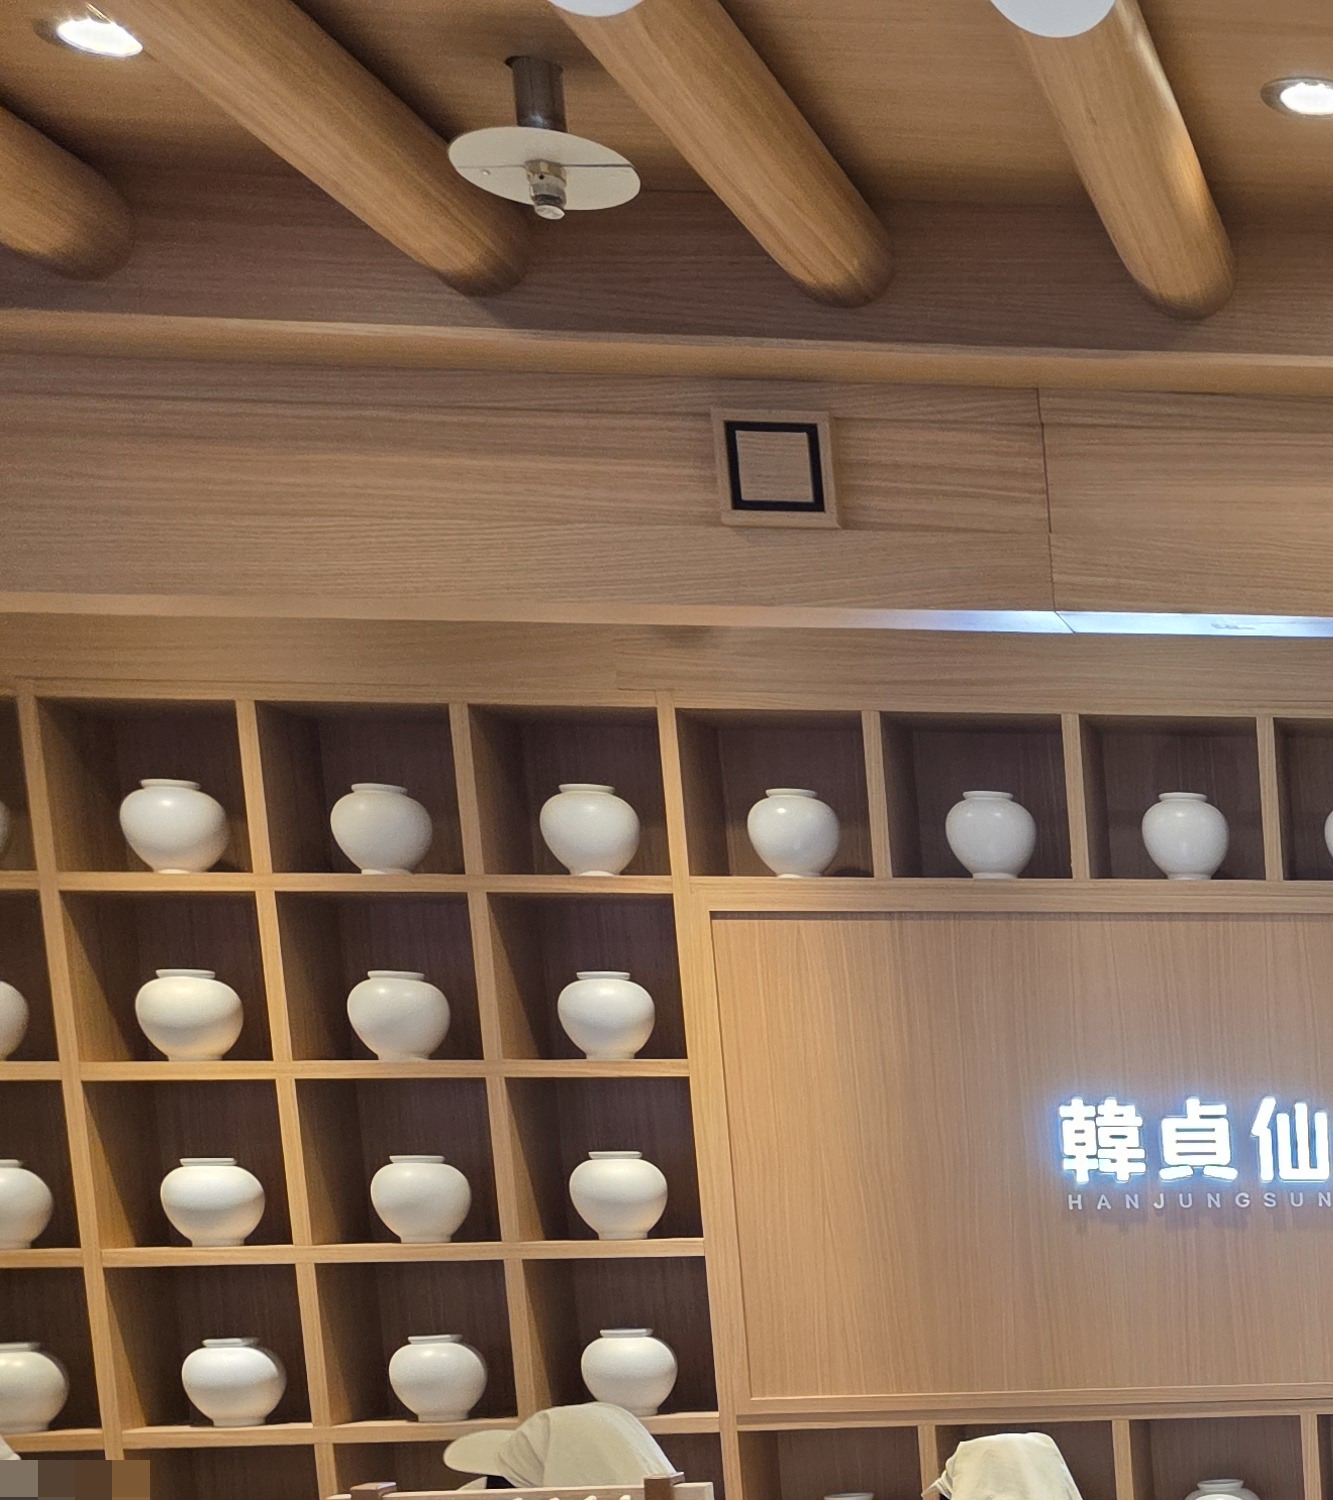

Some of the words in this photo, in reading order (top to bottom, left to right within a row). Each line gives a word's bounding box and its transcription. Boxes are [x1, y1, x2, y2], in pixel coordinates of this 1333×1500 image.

[1058, 1096, 1331, 1183] 韓貞仙
[1067, 1191, 1333, 1210] HANJUNGSUN
